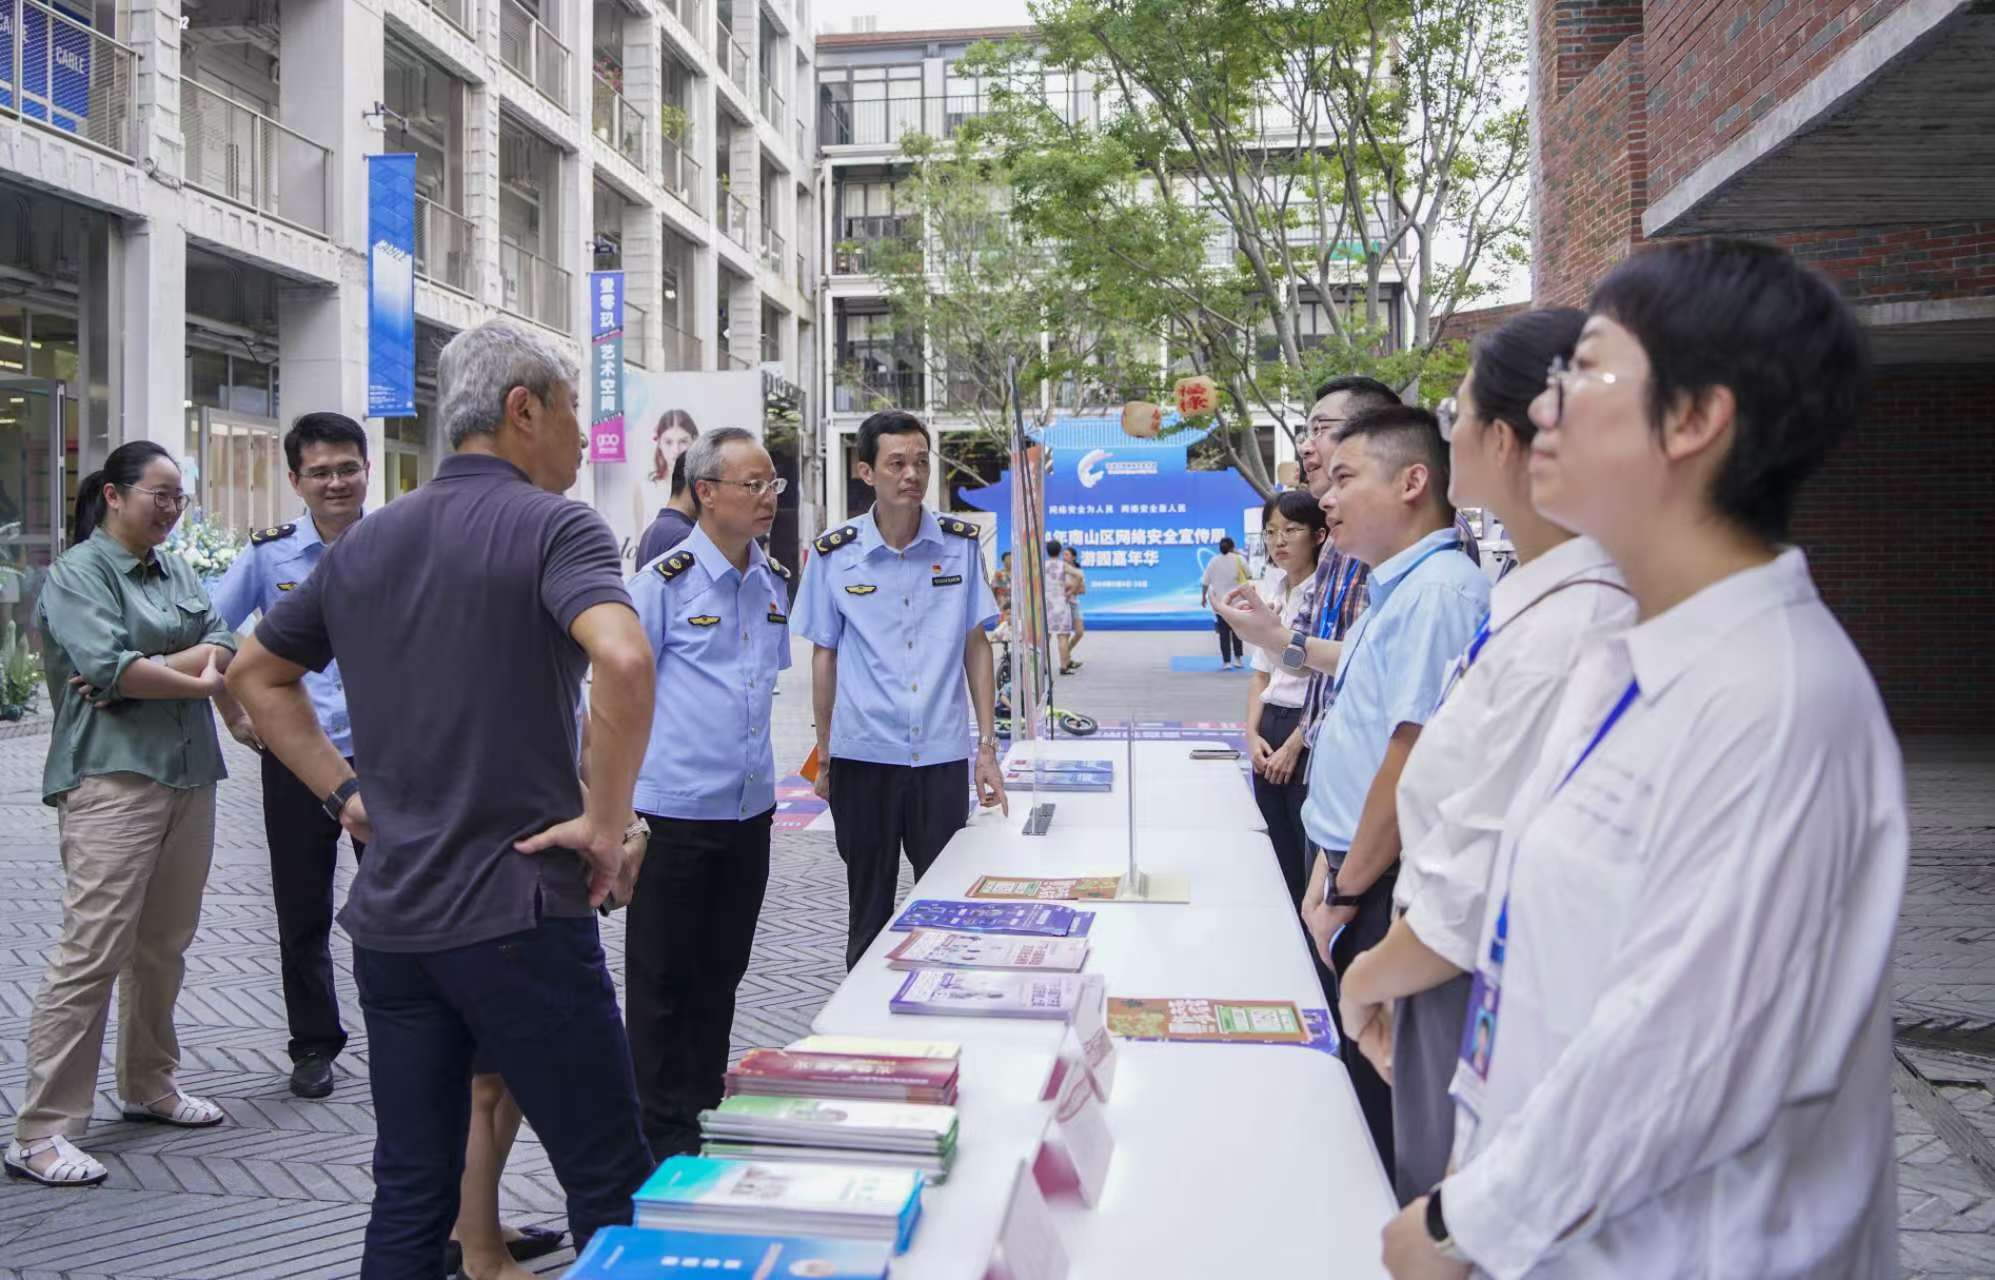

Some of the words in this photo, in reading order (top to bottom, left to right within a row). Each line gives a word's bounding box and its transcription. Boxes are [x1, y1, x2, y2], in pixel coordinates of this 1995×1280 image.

[56, 46, 85, 74] CABLE
[600, 344, 616, 412] 艺术空间
[1081, 550, 1160, 567] 游园嘉年华
